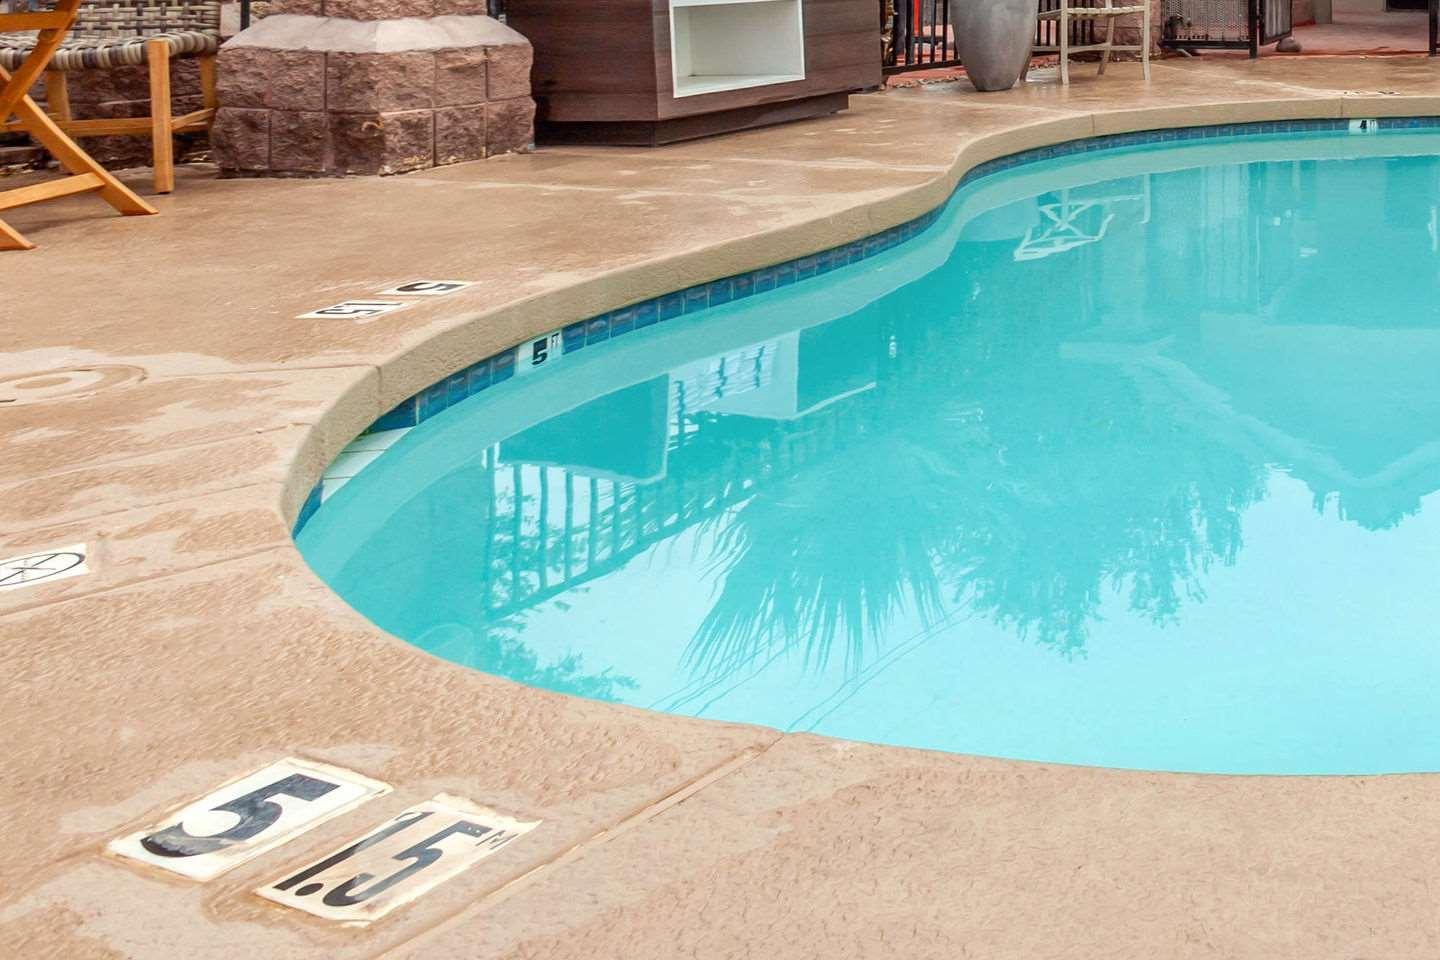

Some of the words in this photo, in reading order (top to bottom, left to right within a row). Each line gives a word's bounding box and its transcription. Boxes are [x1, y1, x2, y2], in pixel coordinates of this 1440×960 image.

[532, 337, 548, 366] 5
[139, 772, 341, 858] 5
[272, 811, 493, 907] 1.5
